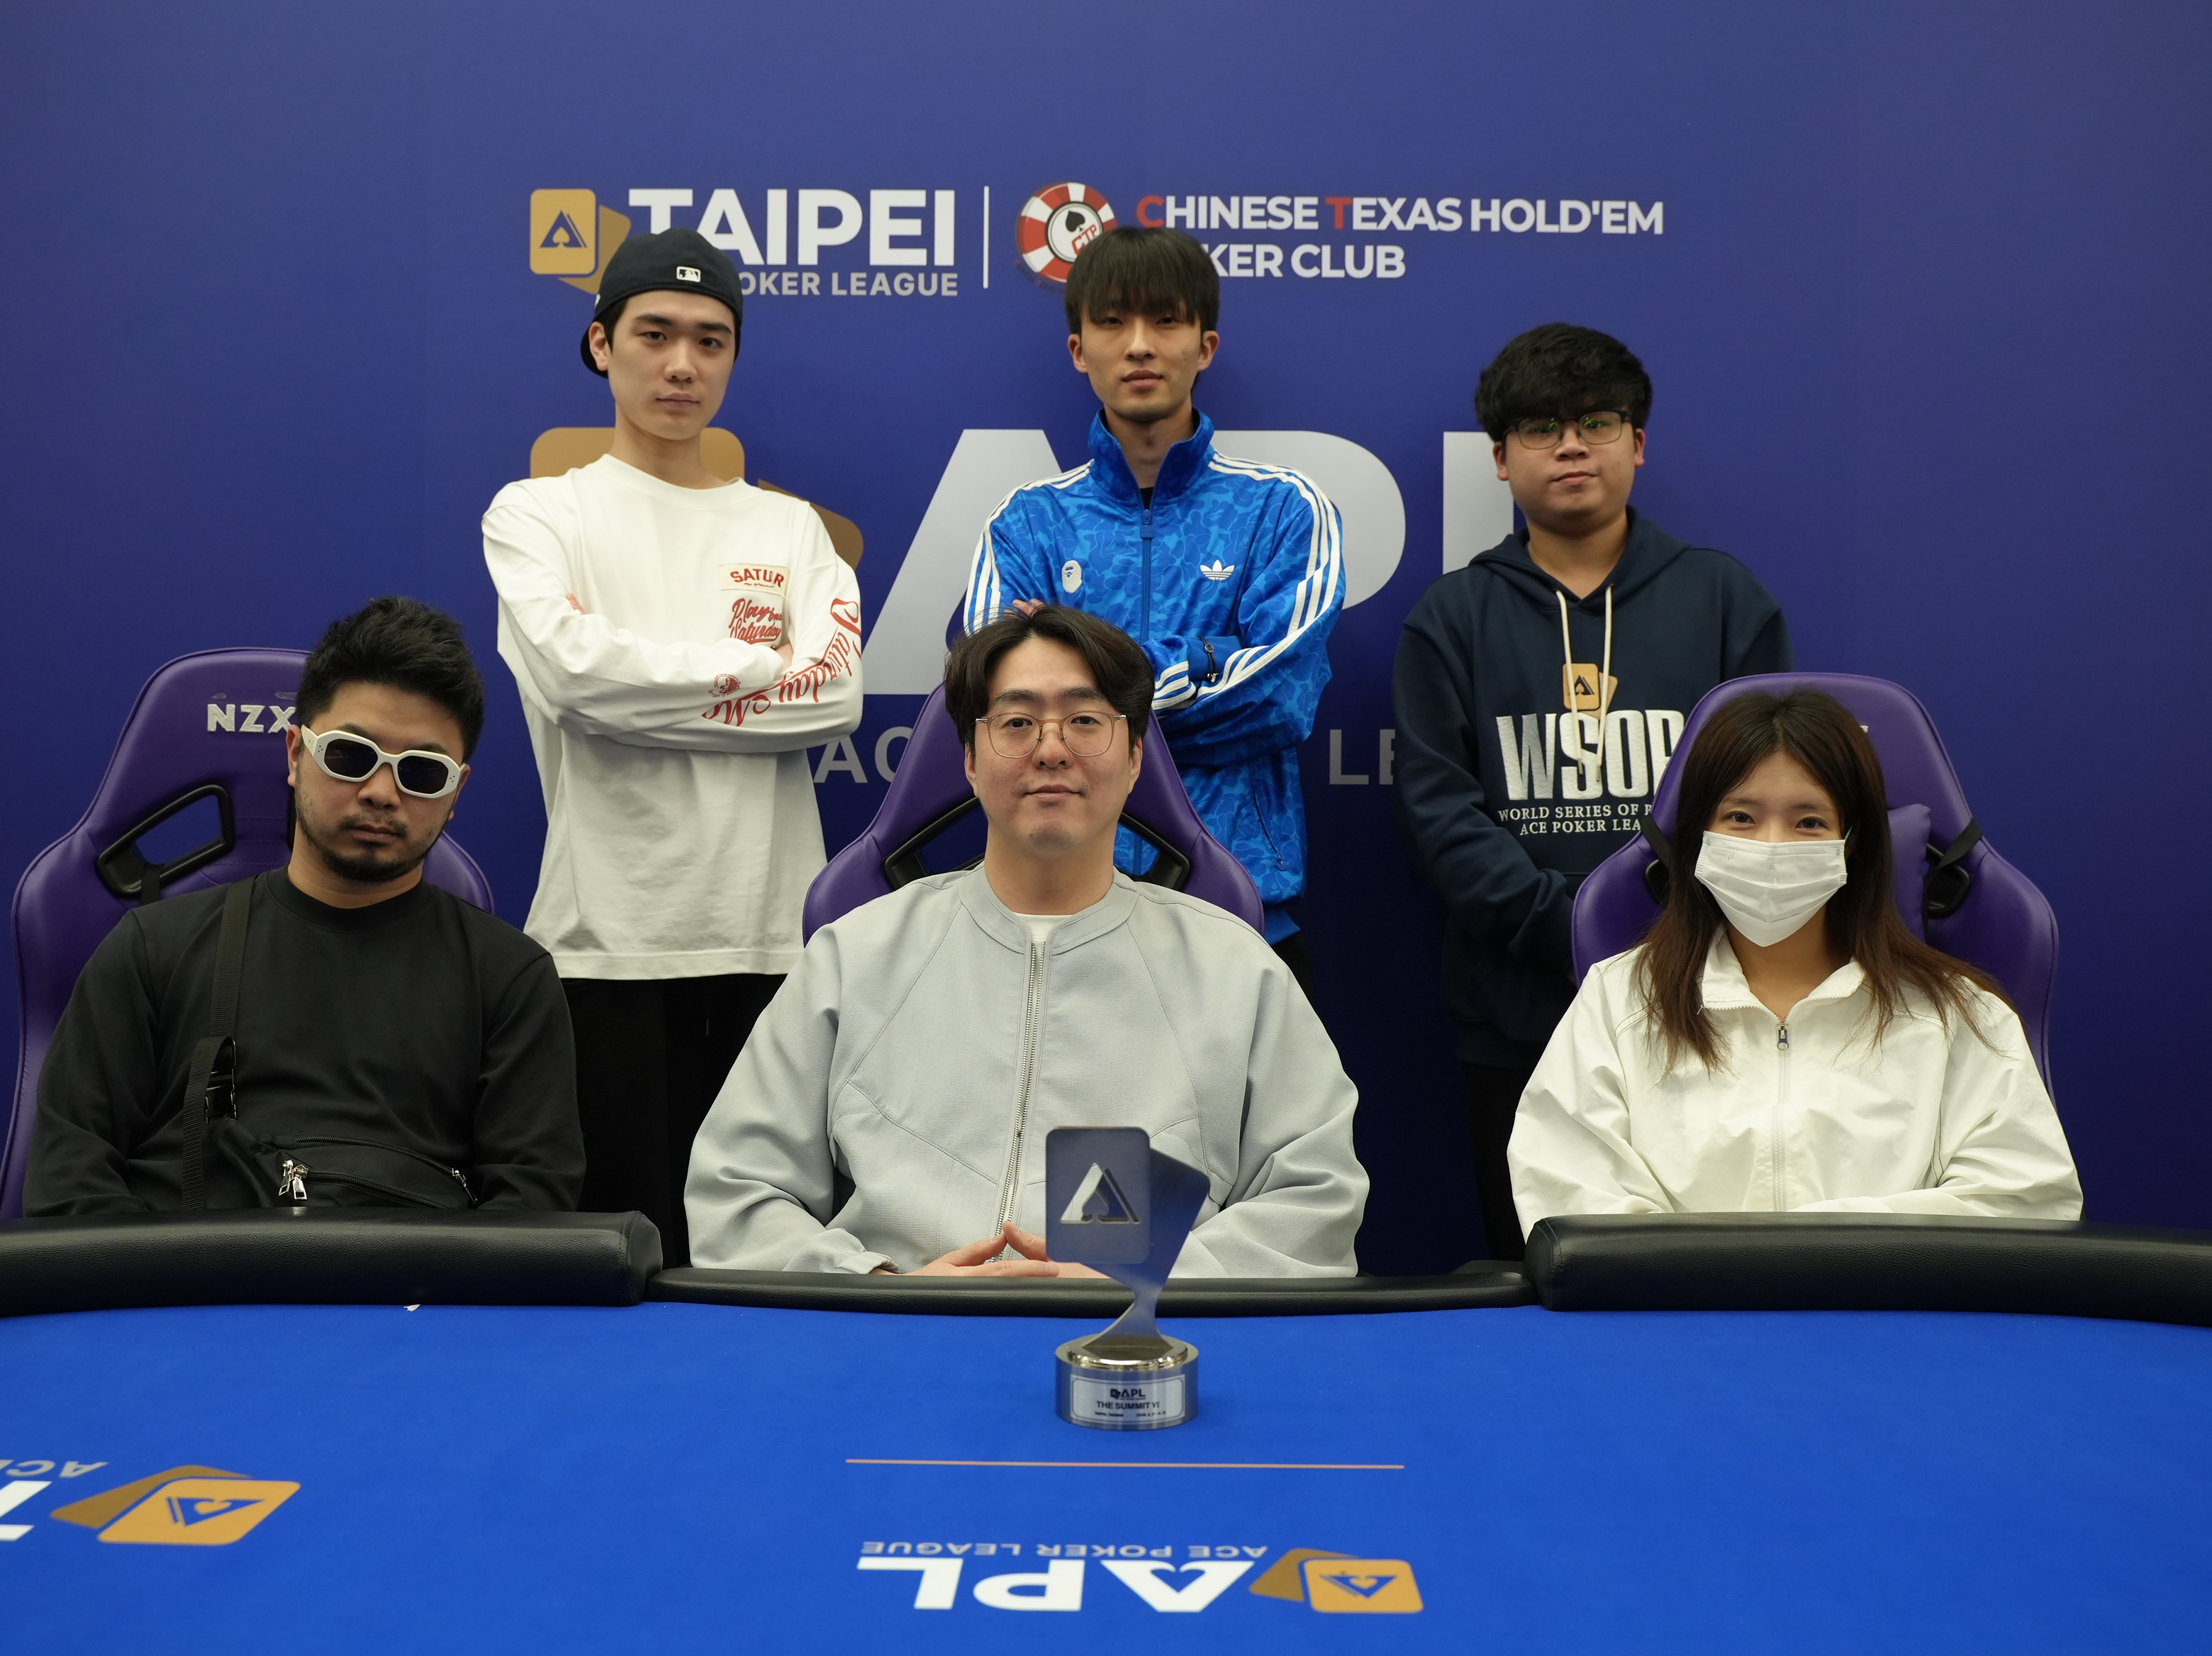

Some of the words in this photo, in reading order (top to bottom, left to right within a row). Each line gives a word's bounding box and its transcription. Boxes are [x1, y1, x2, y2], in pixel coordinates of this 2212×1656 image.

[1136, 196, 1319, 230] CHINESE
[1326, 198, 1463, 231] TEXAS
[1471, 199, 1663, 235] HOLD'EM
[629, 189, 955, 266] TAIPEI
[1201, 243, 1284, 277] KER
[1290, 244, 1406, 279] CLUB
[739, 272, 821, 296] OKER
[832, 272, 959, 296] LEAGUE
[730, 568, 785, 588] SATUR
[1497, 806, 1550, 822] WORLD
[1555, 805, 1611, 818] SERIES
[1617, 803, 1639, 816] OF
[1519, 822, 1548, 836] ACE
[1552, 819, 1607, 834] POKER
[1612, 818, 1641, 831] LEA
[1122, 1389, 1146, 1398] APL
[1096, 1401, 1113, 1409] THE
[1115, 1402, 1150, 1410] SUMMIT
[861, 1541, 1021, 1556] LEAGUE
[1036, 1543, 1173, 1557] POKER
[1188, 1545, 1268, 1558] ACE
[857, 1557, 1256, 1613] APL
